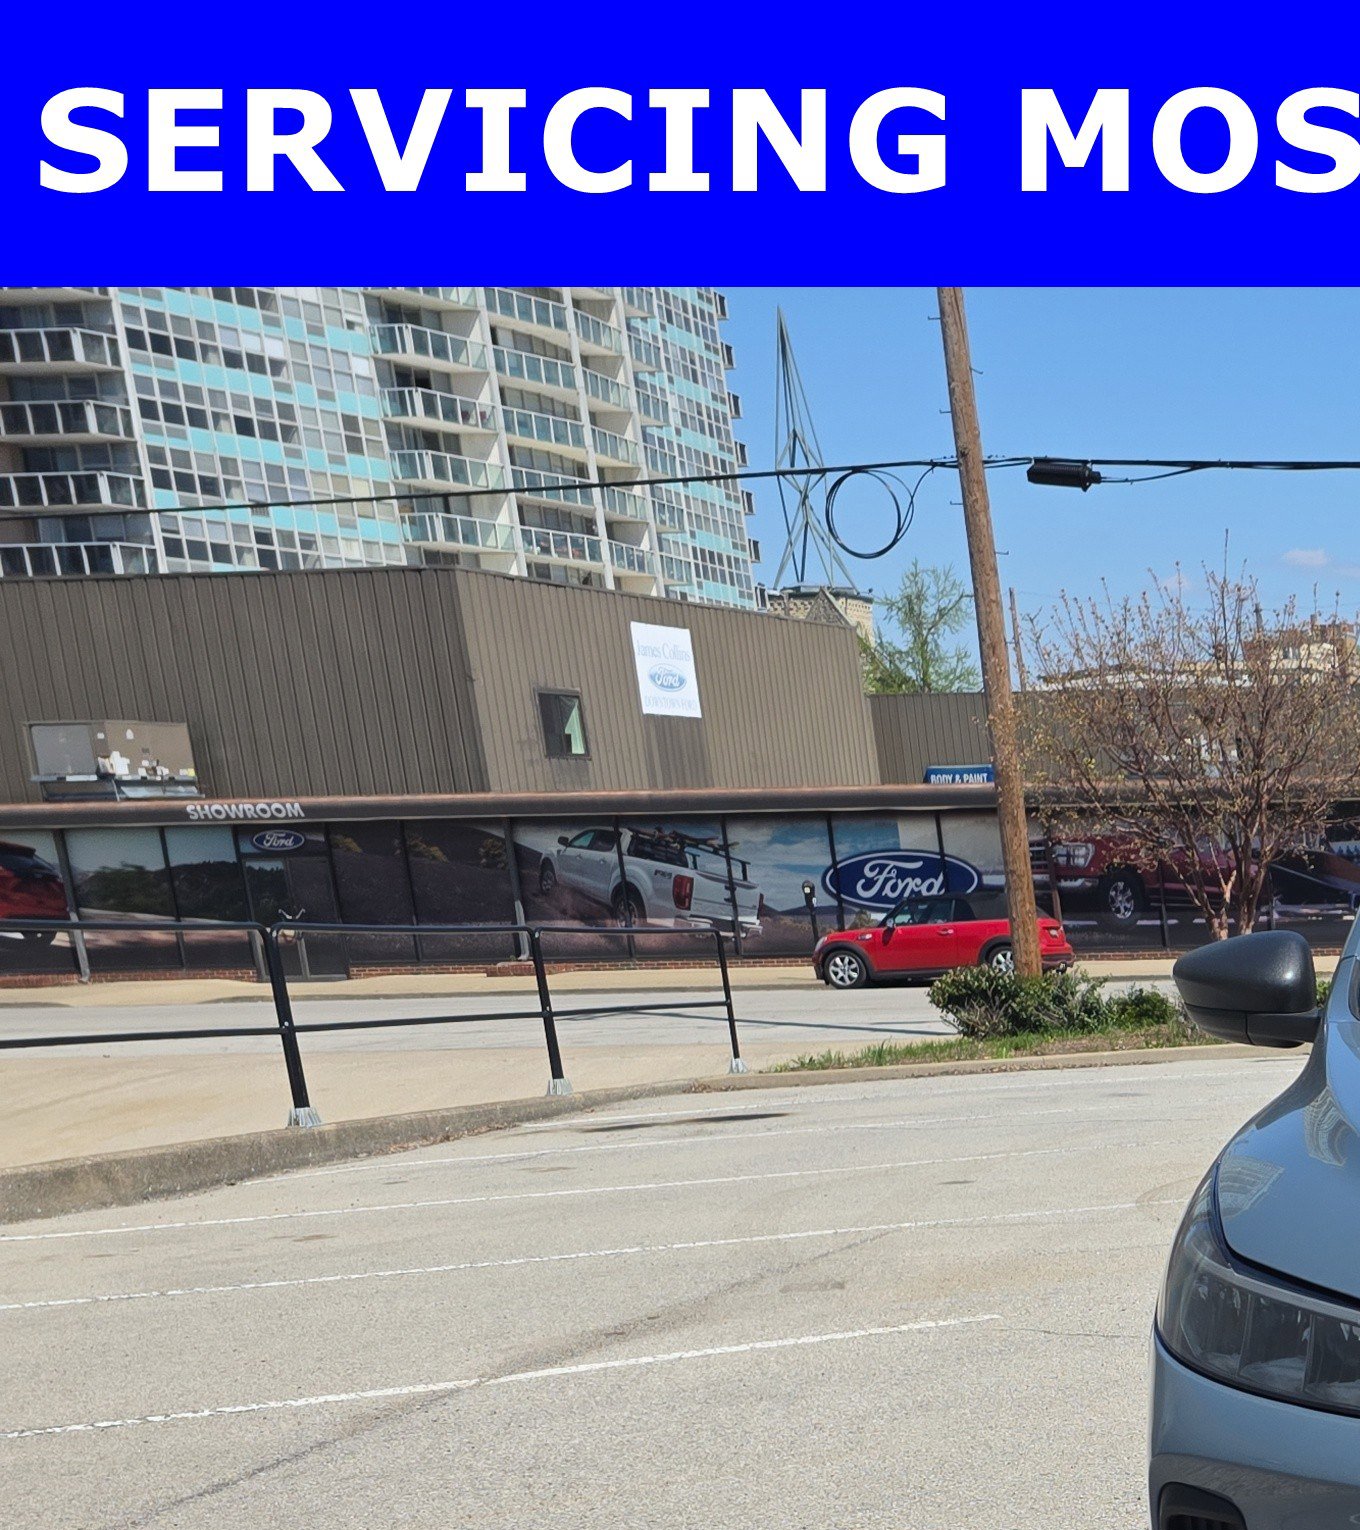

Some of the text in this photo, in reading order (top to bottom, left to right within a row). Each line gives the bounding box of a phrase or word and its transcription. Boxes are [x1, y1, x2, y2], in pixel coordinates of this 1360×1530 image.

[655, 667, 681, 687] Ford
[930, 774, 953, 784] BODY
[963, 772, 988, 784] PAINT
[186, 802, 305, 820] SHOWROOM
[263, 833, 294, 847] Ford
[856, 859, 946, 899] Ford
